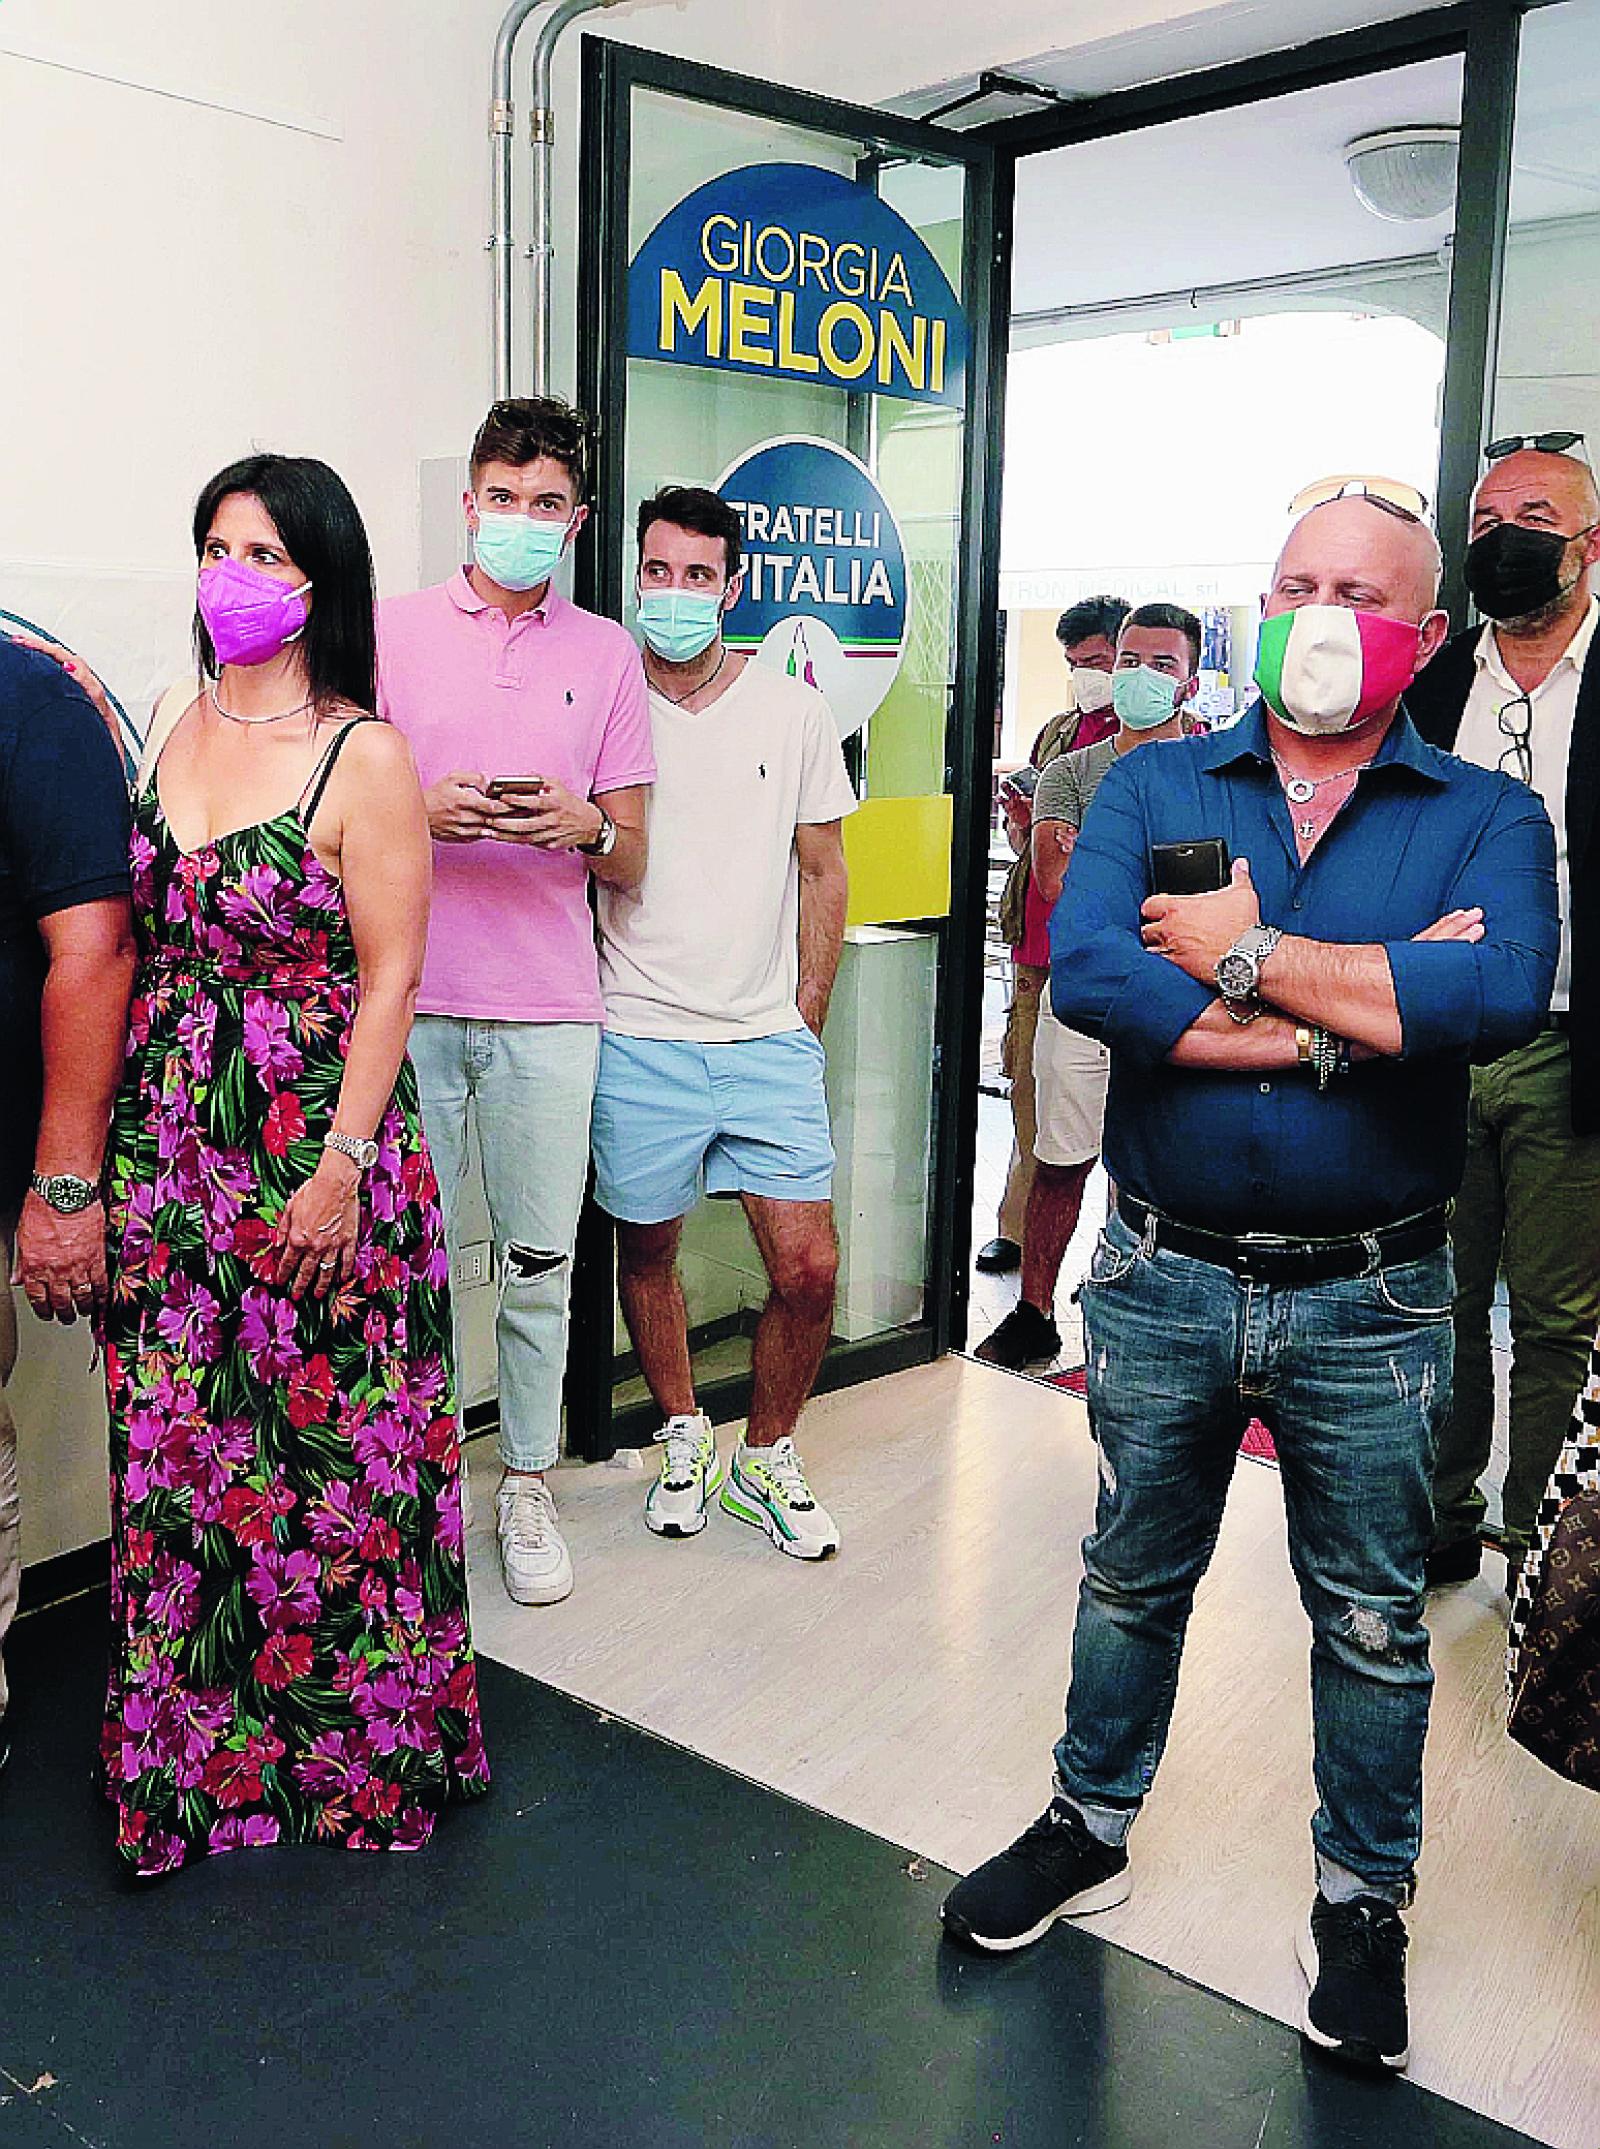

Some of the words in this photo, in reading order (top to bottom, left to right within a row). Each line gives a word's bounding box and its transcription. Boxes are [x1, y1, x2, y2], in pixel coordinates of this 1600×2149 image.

[701, 214, 913, 307] GIORGIA
[658, 268, 946, 393] MELONI
[739, 553, 895, 606] 'ITALIA
